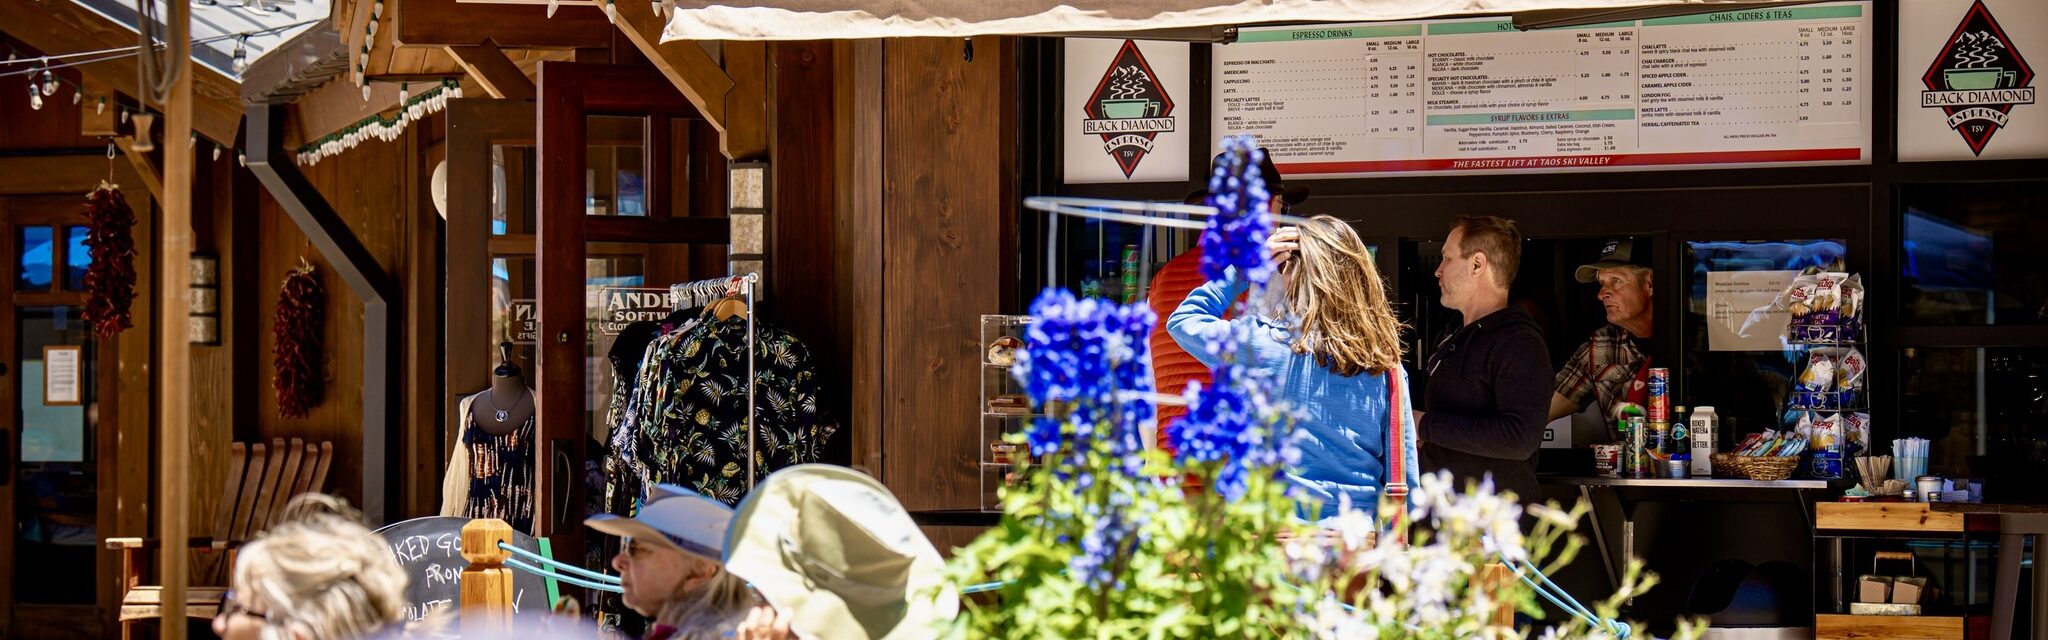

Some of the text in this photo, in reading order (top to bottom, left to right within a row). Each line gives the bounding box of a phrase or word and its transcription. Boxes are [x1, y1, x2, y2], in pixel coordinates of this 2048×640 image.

[1737, 12, 1763, 20] CIDERS
[1292, 29, 1352, 39] ESPRESSO DRINKS
[1925, 90, 2032, 104] BLACK DIAMOND
[1949, 108, 2006, 125] ESPRESSO
[1086, 119, 1173, 131] BLACK DIAMOND
[1106, 136, 1151, 150] ESPRESSO
[1579, 157, 1610, 165] VALLEY
